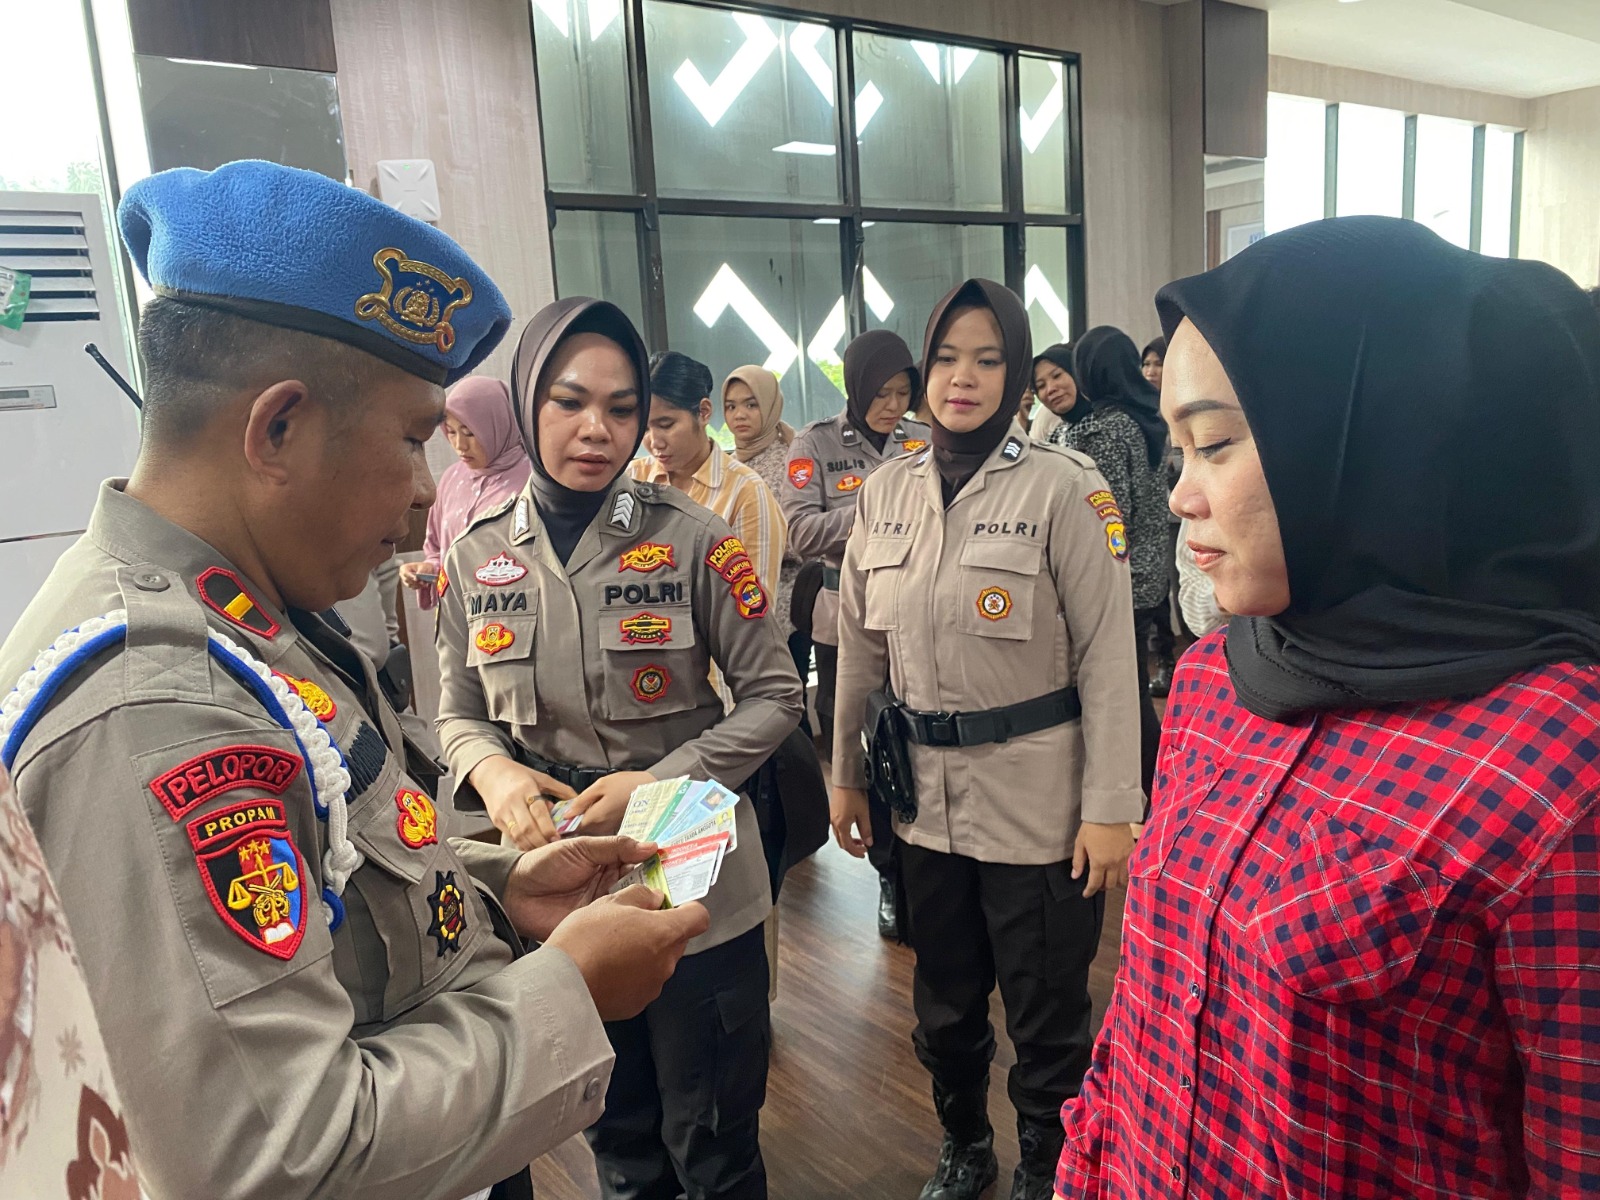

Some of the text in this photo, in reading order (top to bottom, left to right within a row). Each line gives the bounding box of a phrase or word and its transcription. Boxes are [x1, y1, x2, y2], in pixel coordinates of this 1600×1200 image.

[827, 459, 866, 473] SULIS
[973, 521, 1037, 538] POLRI
[470, 592, 527, 616] MAYA
[604, 582, 683, 606] POLRI
[167, 754, 291, 806] PELOPOR
[205, 806, 276, 837] PROPAM
